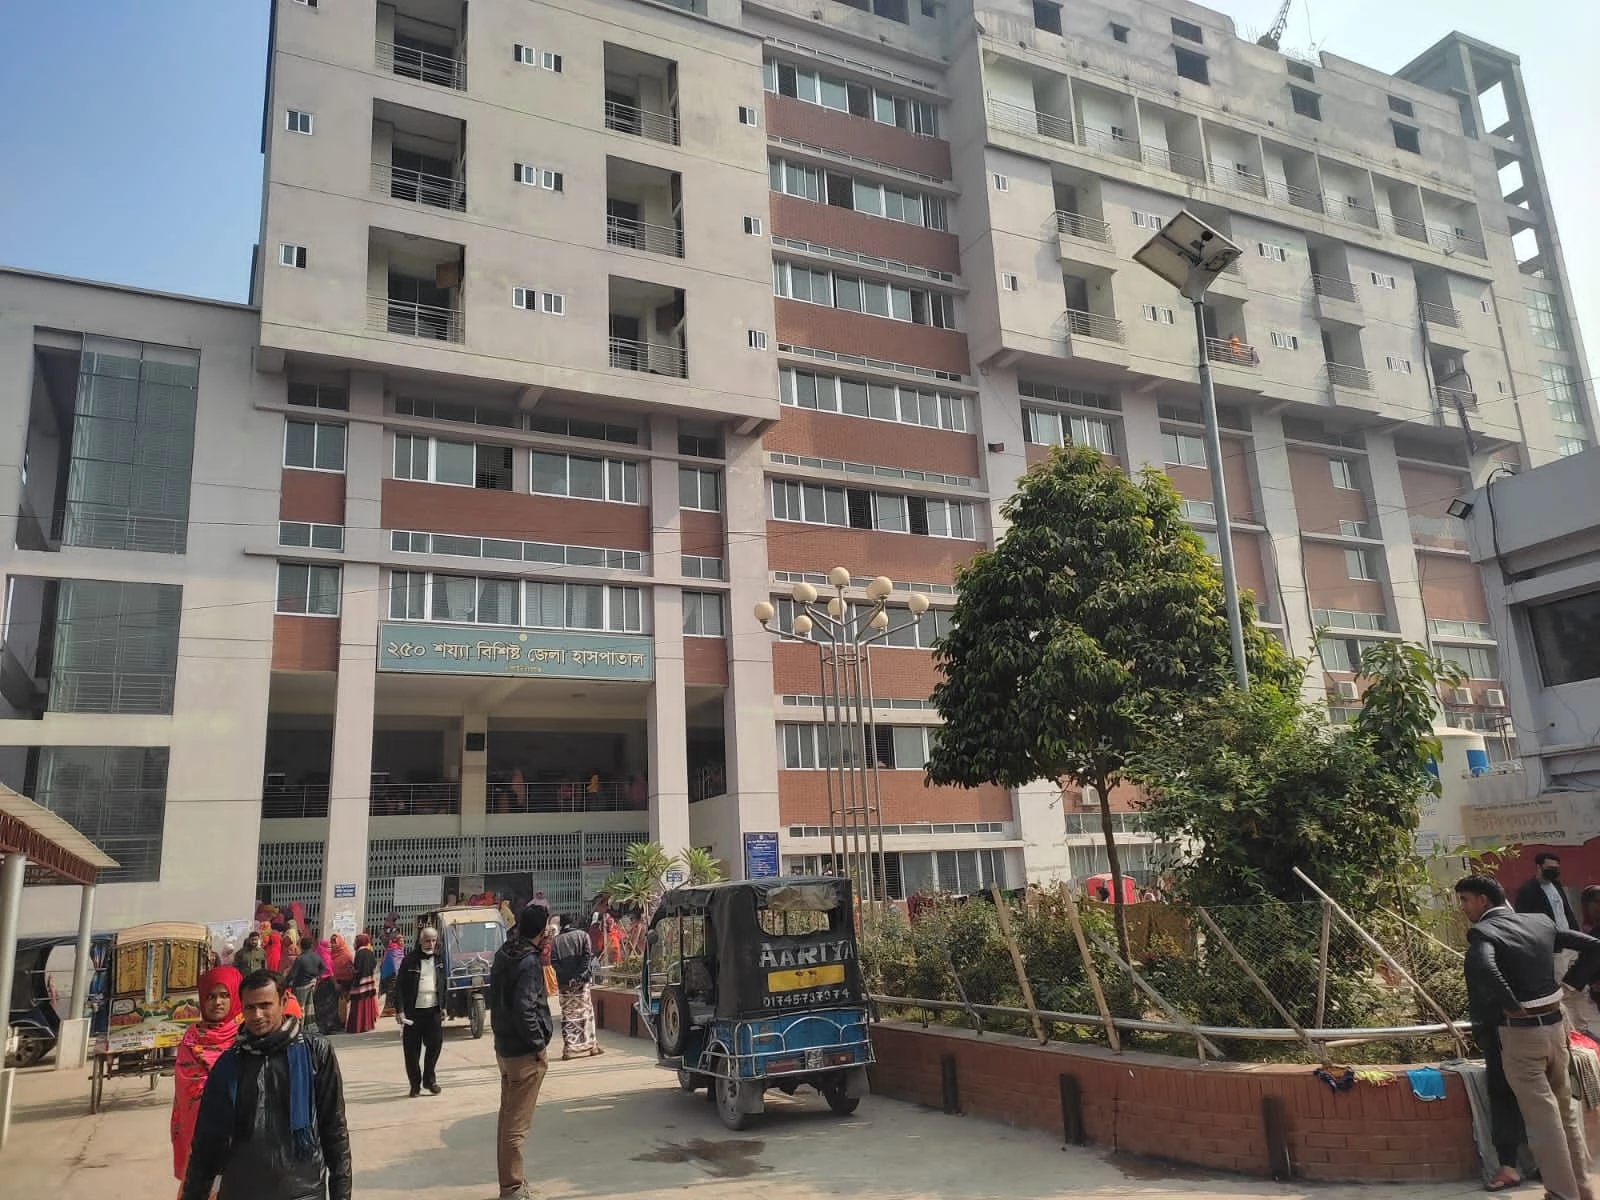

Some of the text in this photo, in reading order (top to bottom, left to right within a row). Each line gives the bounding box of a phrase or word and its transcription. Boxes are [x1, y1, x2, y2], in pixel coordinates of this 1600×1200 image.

[387, 640, 645, 667] ২৫০ শয্যা বিশিষ্ট জেলা হাসপাতাল
